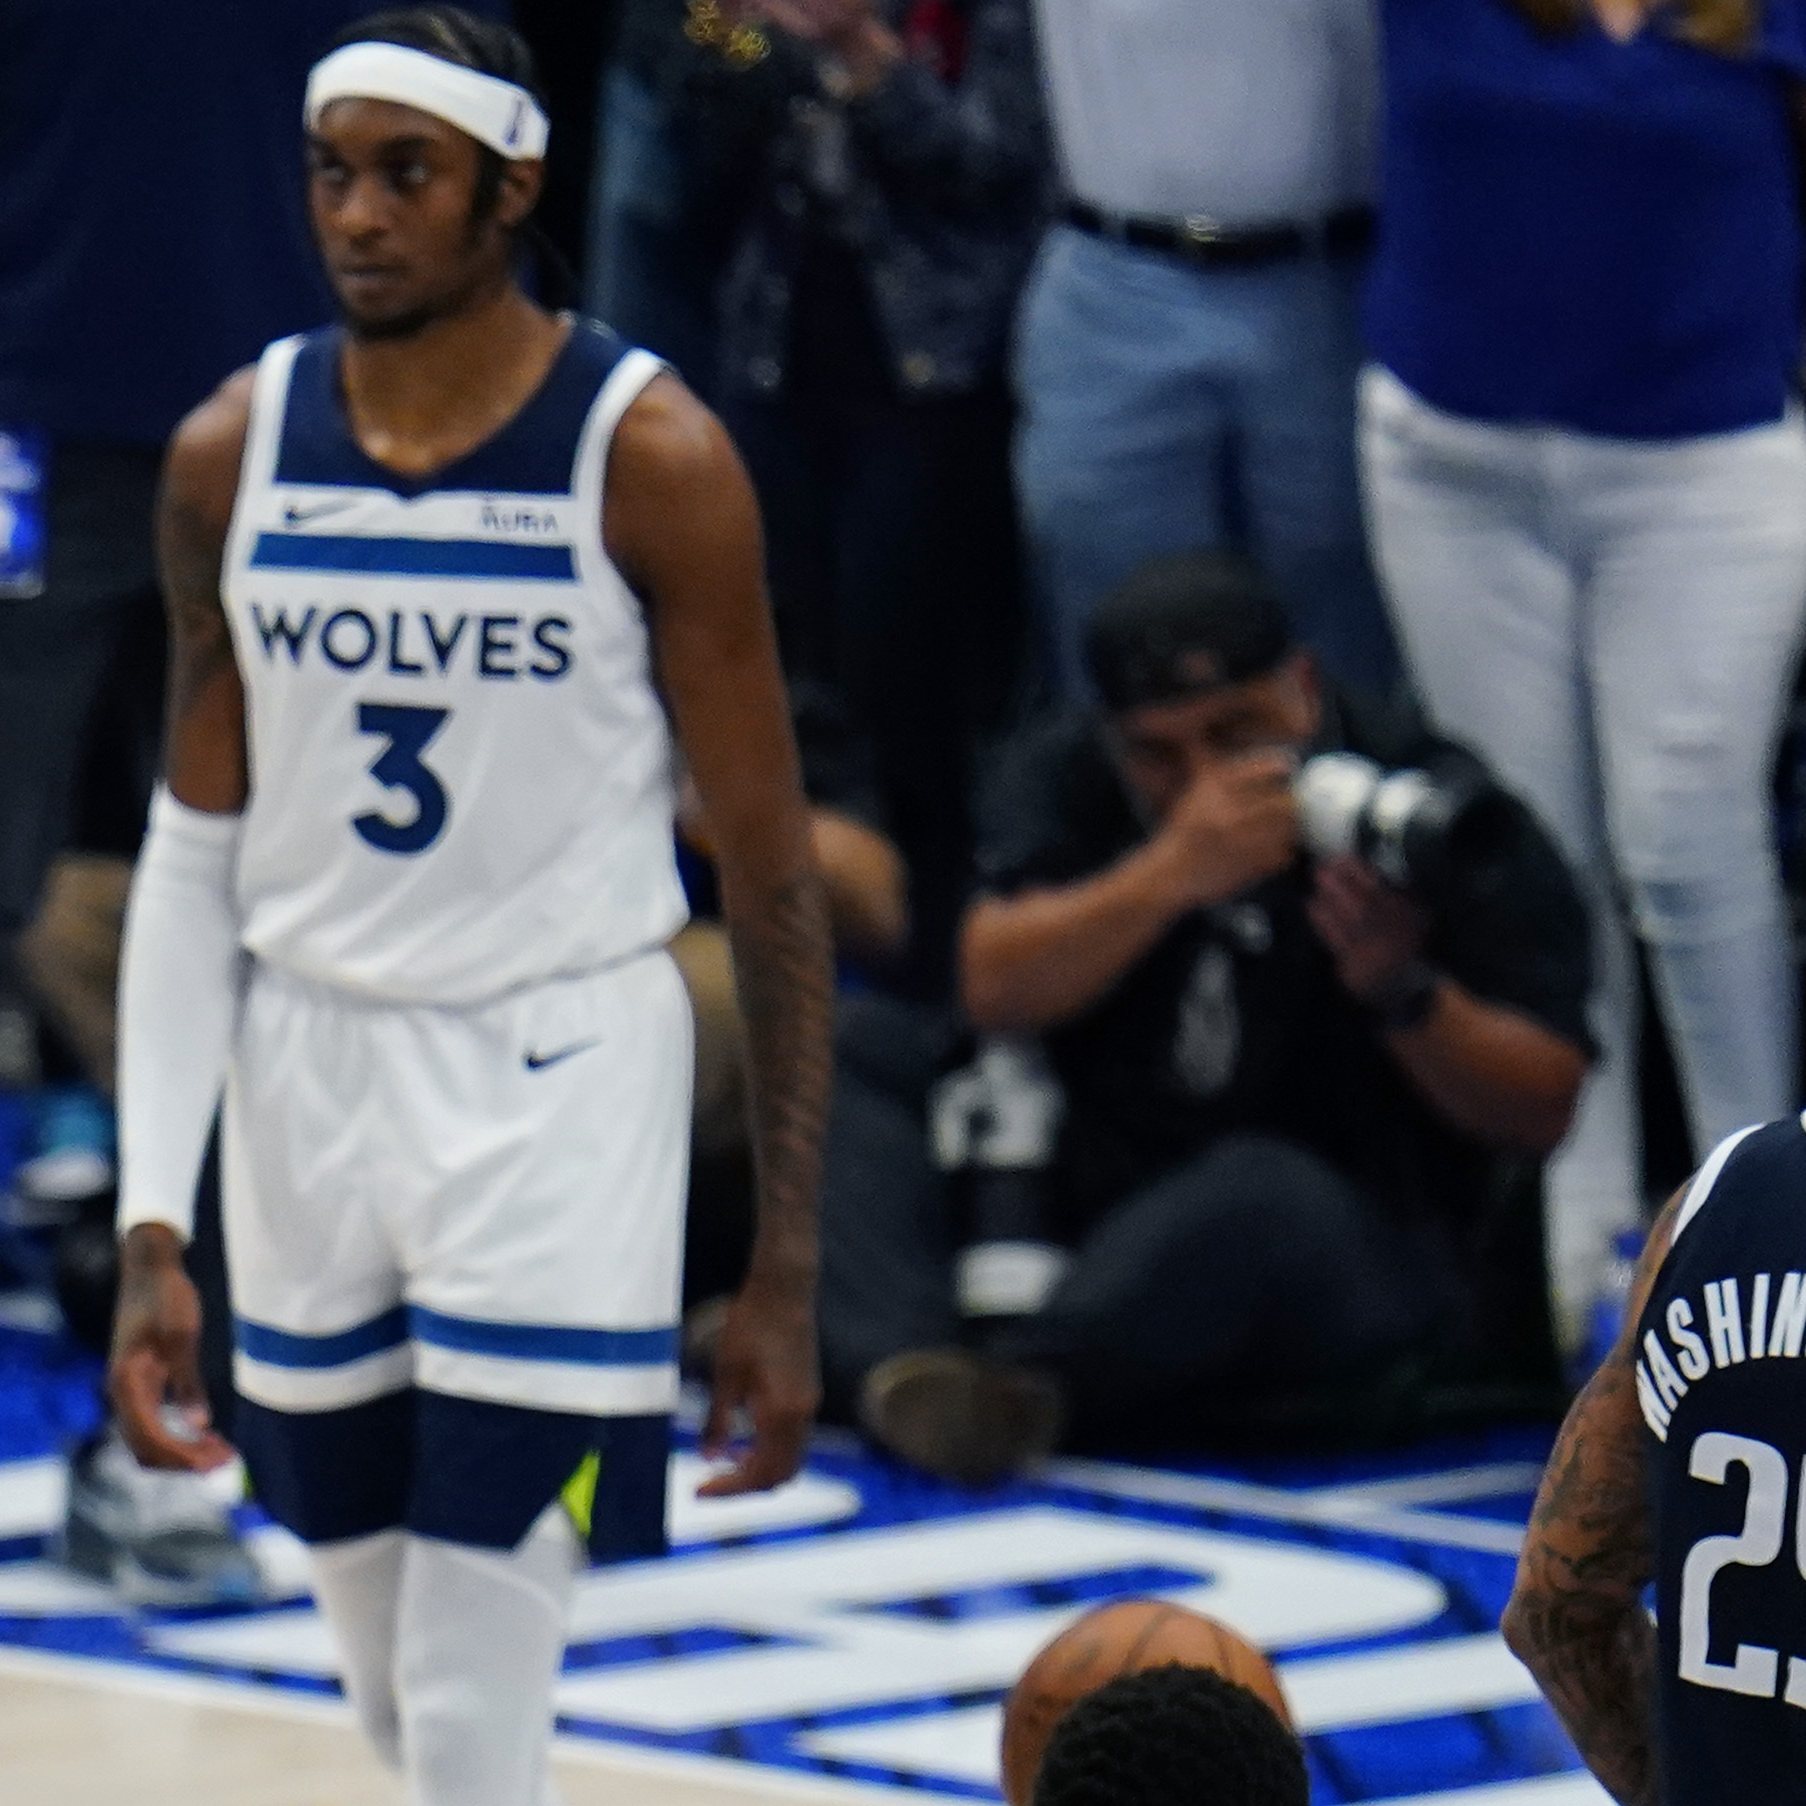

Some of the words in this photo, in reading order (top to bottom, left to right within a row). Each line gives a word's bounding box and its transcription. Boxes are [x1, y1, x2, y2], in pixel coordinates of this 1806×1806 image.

[252, 604, 572, 678] WOLVES
[352, 704, 449, 854] 3
[1678, 1431, 1806, 1712] 2
